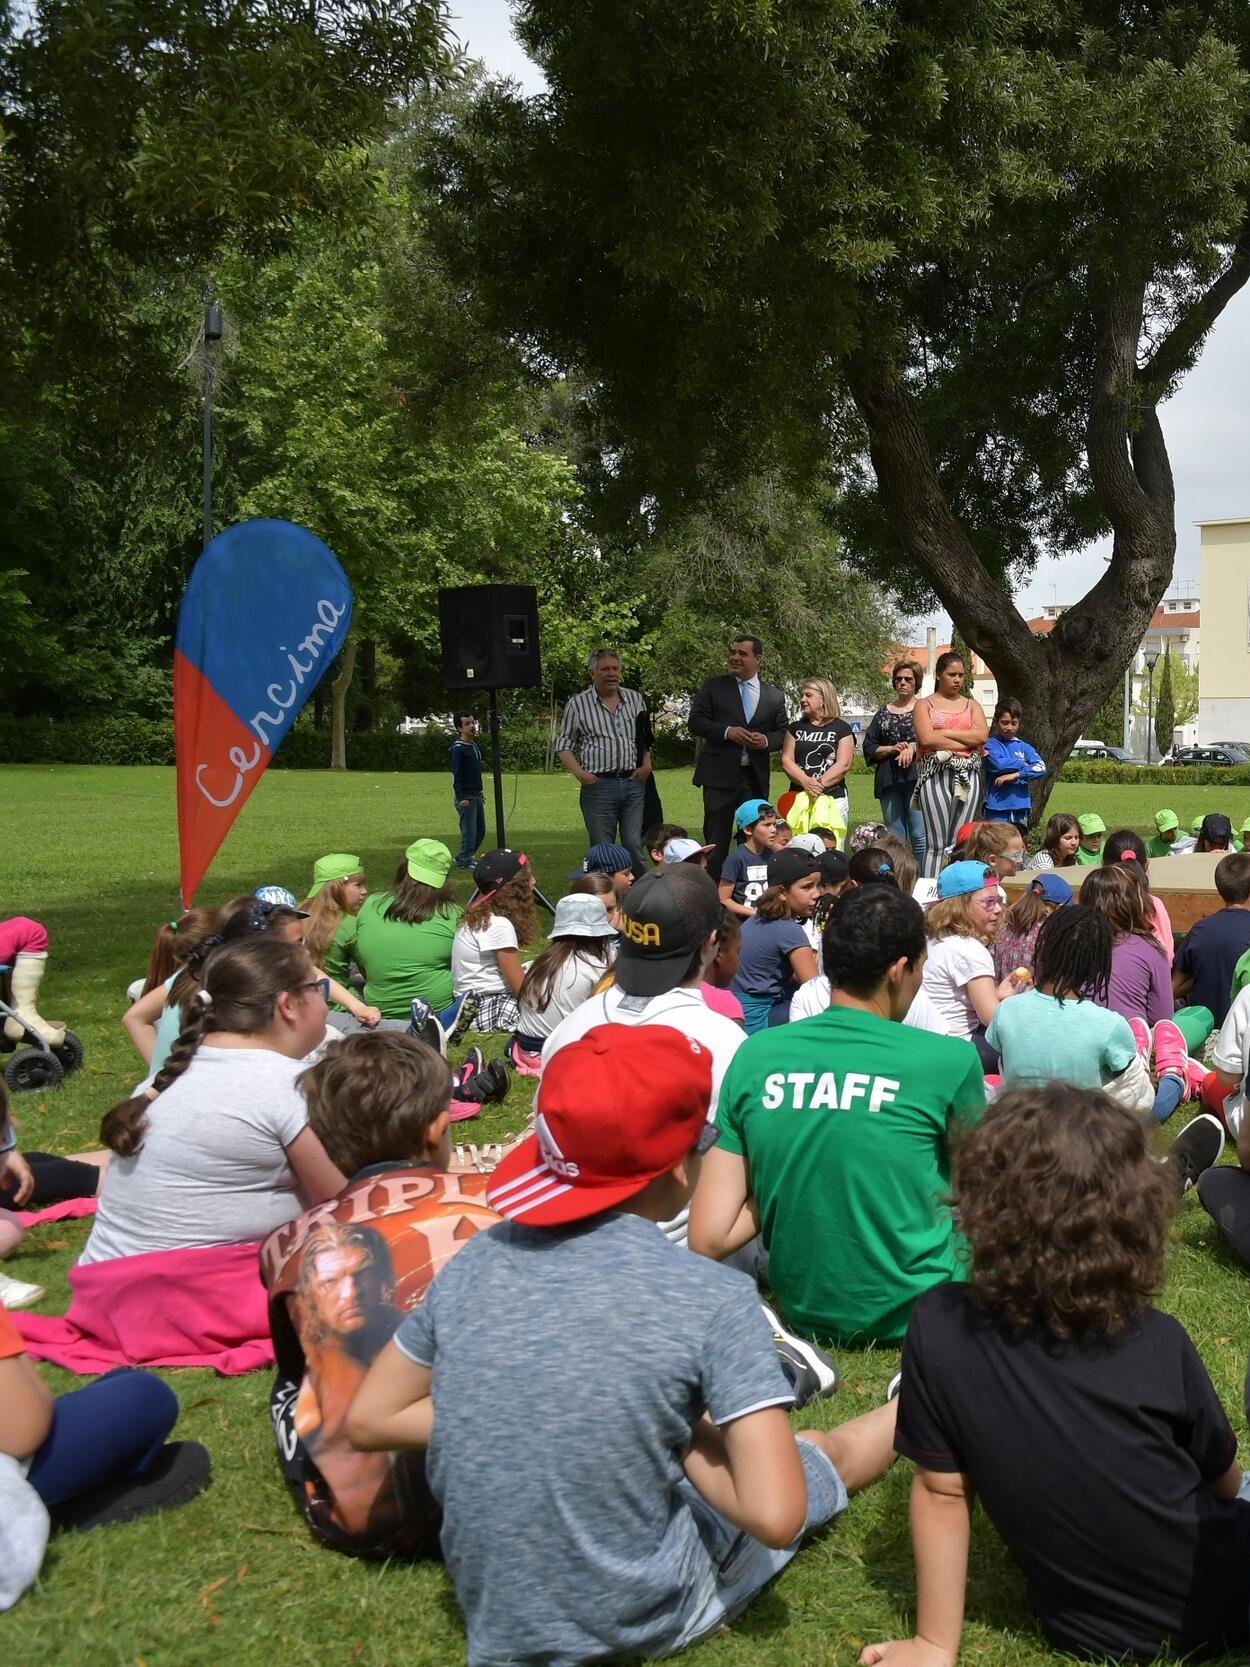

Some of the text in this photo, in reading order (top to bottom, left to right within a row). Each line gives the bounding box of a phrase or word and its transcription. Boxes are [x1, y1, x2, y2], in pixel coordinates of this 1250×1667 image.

[196, 600, 346, 807] Cencima
[795, 730, 837, 742] SMILE
[623, 914, 661, 946] USA
[762, 1072, 900, 1112] STAFF
